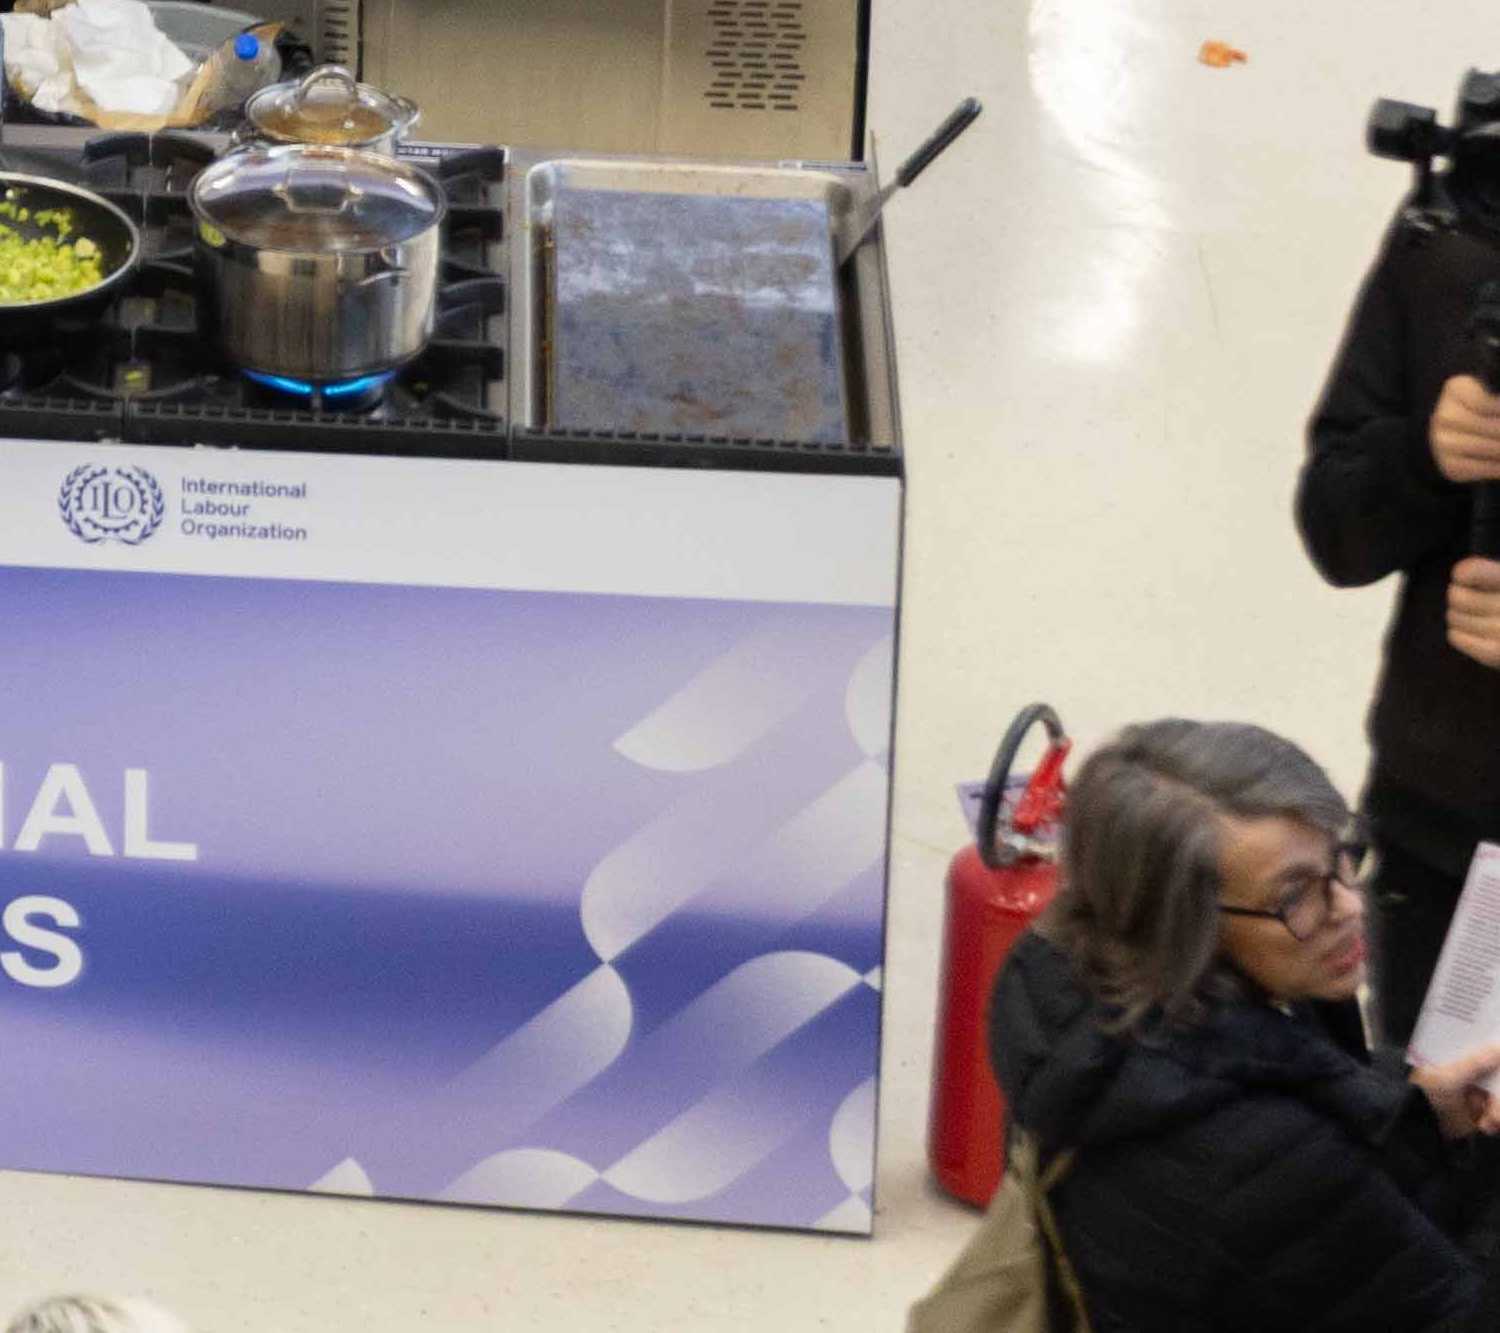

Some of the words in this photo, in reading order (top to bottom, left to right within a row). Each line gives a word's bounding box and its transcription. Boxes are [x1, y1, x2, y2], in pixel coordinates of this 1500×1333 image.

[181, 476, 307, 499] International
[181, 499, 250, 517] Labour
[181, 519, 308, 541] Organization
